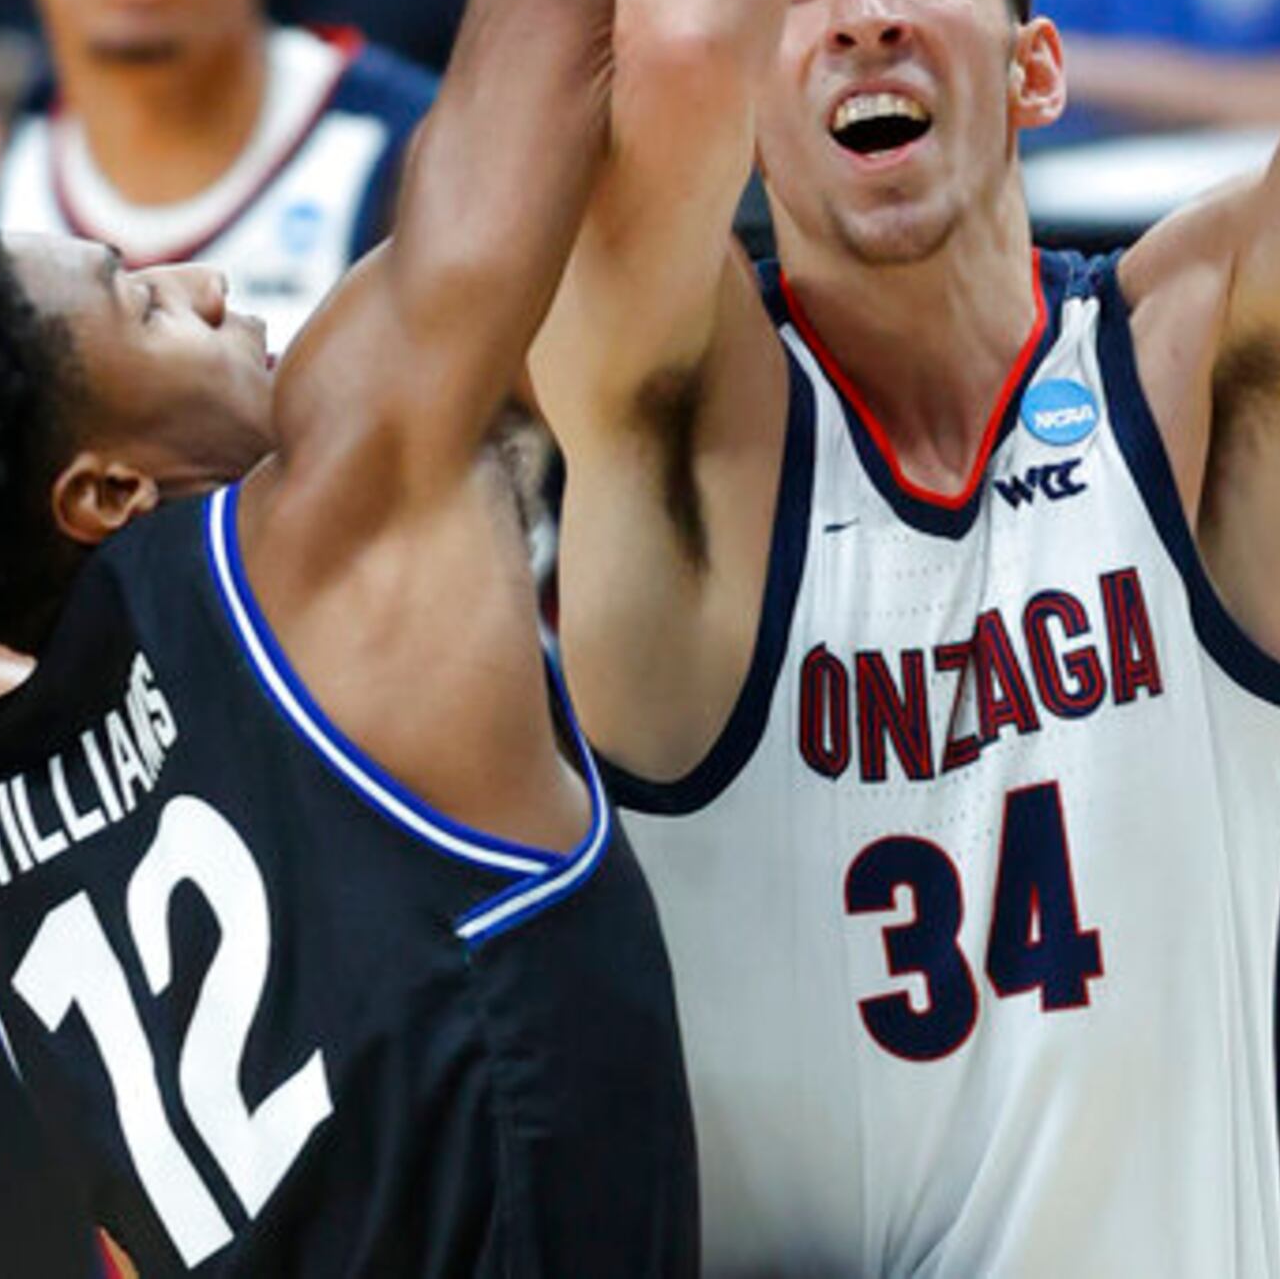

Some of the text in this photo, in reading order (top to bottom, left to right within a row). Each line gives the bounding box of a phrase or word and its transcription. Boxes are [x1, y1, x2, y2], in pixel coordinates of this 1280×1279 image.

[992, 457, 1088, 510] WCC
[1033, 404, 1095, 430] NCAA
[844, 780, 1105, 1062] 34
[11, 794, 334, 1270] 12
